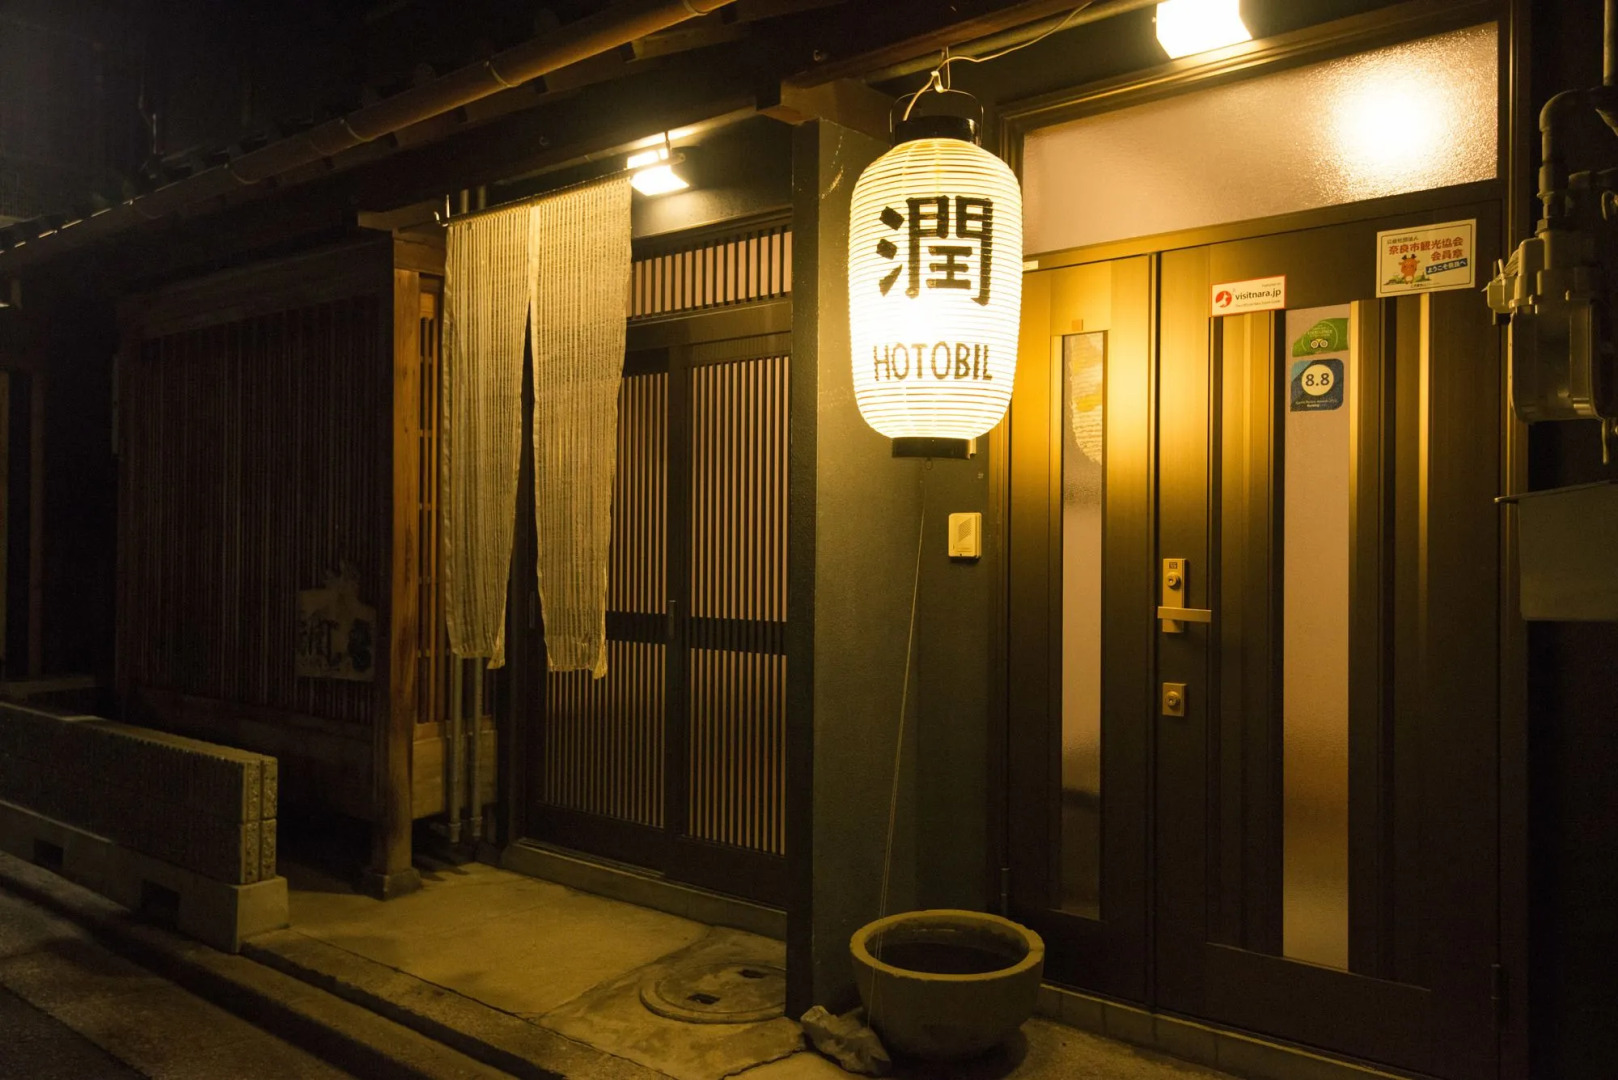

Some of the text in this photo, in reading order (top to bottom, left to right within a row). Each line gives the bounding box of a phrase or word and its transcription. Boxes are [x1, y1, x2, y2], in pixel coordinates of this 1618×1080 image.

[876, 195, 993, 307] 潤
[1388, 236, 1464, 256] 奈良市観光協会
[1235, 288, 1282, 300] visitnara.jp
[872, 341, 993, 382] HOTOBIL
[1305, 372, 1330, 387] 8.8
